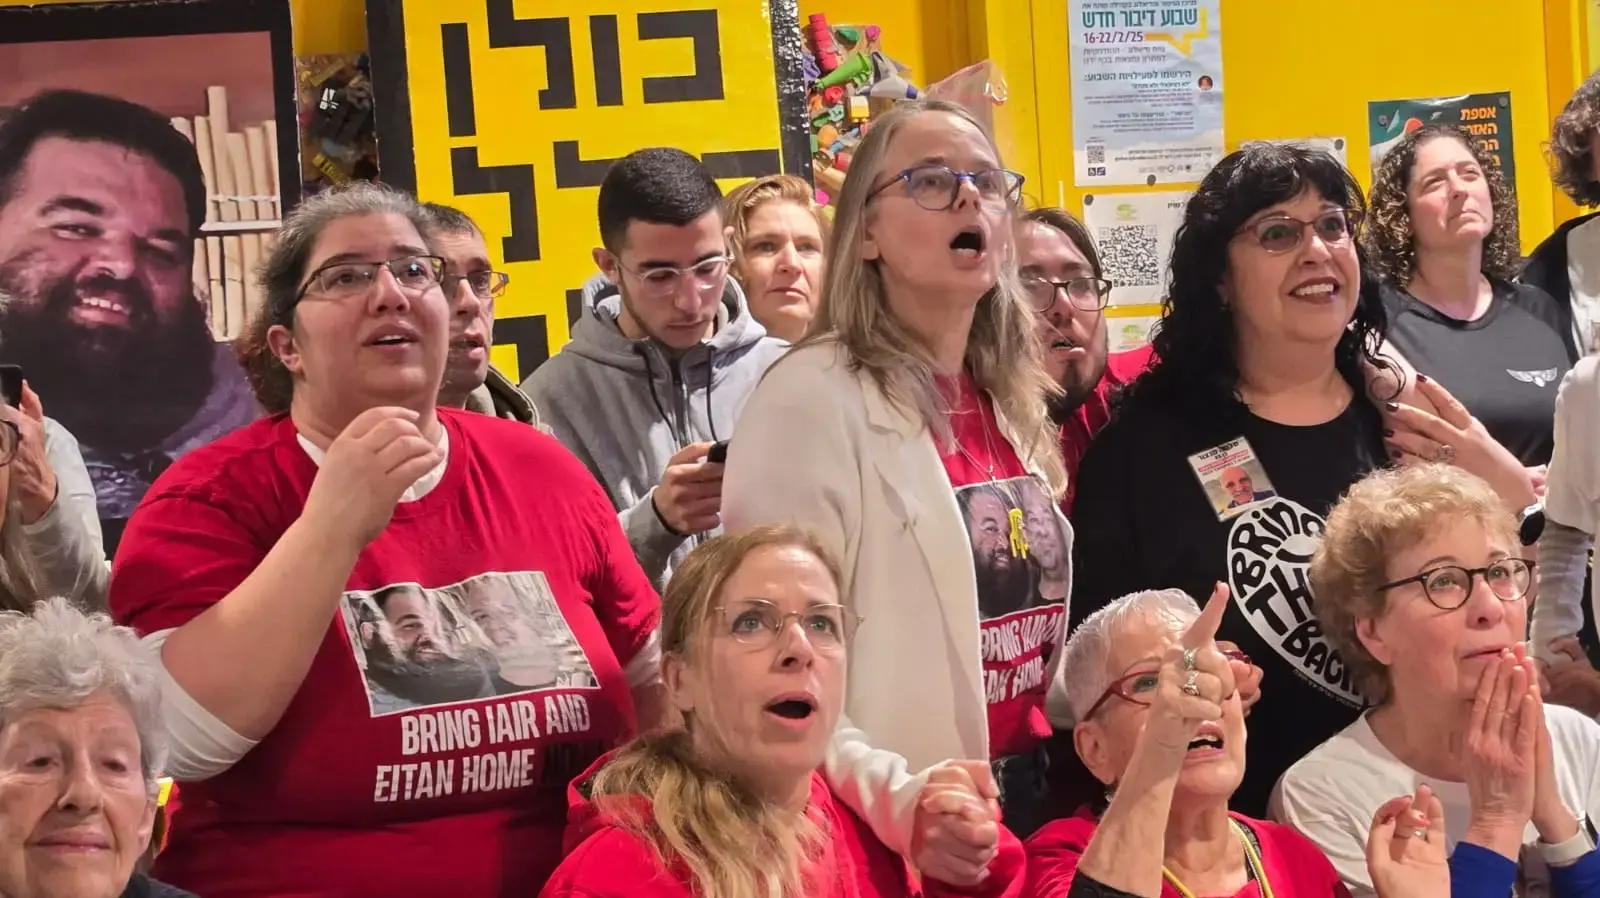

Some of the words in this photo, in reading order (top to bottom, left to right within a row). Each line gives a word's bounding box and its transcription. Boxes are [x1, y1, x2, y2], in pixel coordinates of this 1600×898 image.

[1082, 11, 1116, 28] חדש
[1120, 10, 1156, 27] דיבור
[1160, 8, 1198, 26] שבוע
[1083, 31, 1144, 44] 16-22/2/25
[441, 0, 725, 138] כולן
[1118, 70, 1159, 81] לפעילויות
[1161, 70, 1192, 79] הירשמו
[1084, 73, 1117, 82] השבוע:
[1460, 106, 1497, 121] אספת
[1465, 121, 1498, 136] האזר
[401, 708, 482, 756] BRING
[485, 700, 541, 745] IAIR
[544, 694, 591, 735] AND
[373, 759, 455, 803] EITAN
[461, 749, 536, 794] HOME
